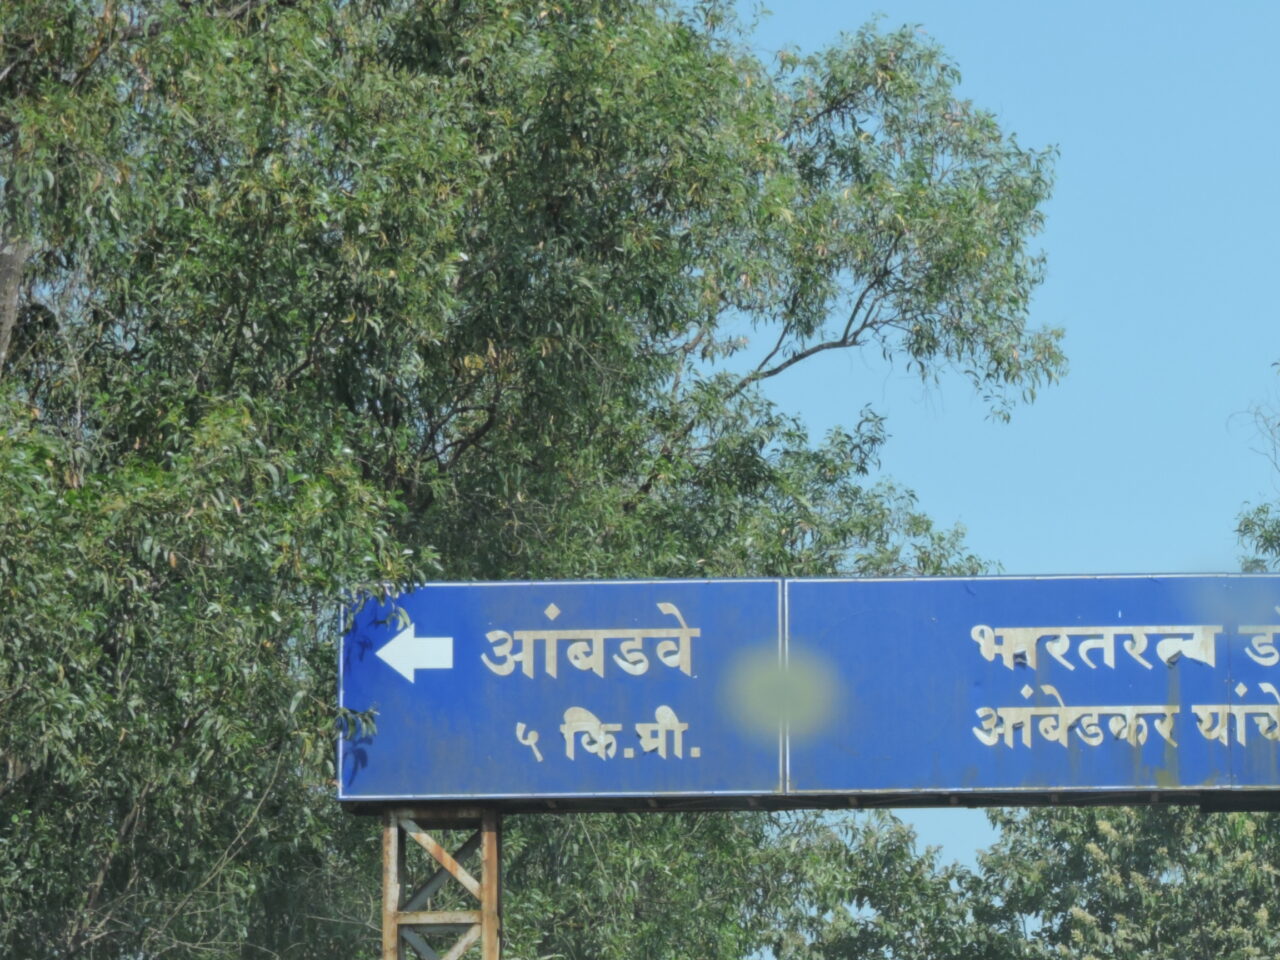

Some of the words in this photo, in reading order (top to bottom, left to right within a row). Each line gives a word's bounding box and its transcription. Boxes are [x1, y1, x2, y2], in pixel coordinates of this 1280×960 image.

[480, 602, 701, 679] आंबडवे
[970, 624, 1223, 671] भारतरत्न
[516, 722, 544, 762] ५
[972, 682, 1181, 749] आंबेडकर
